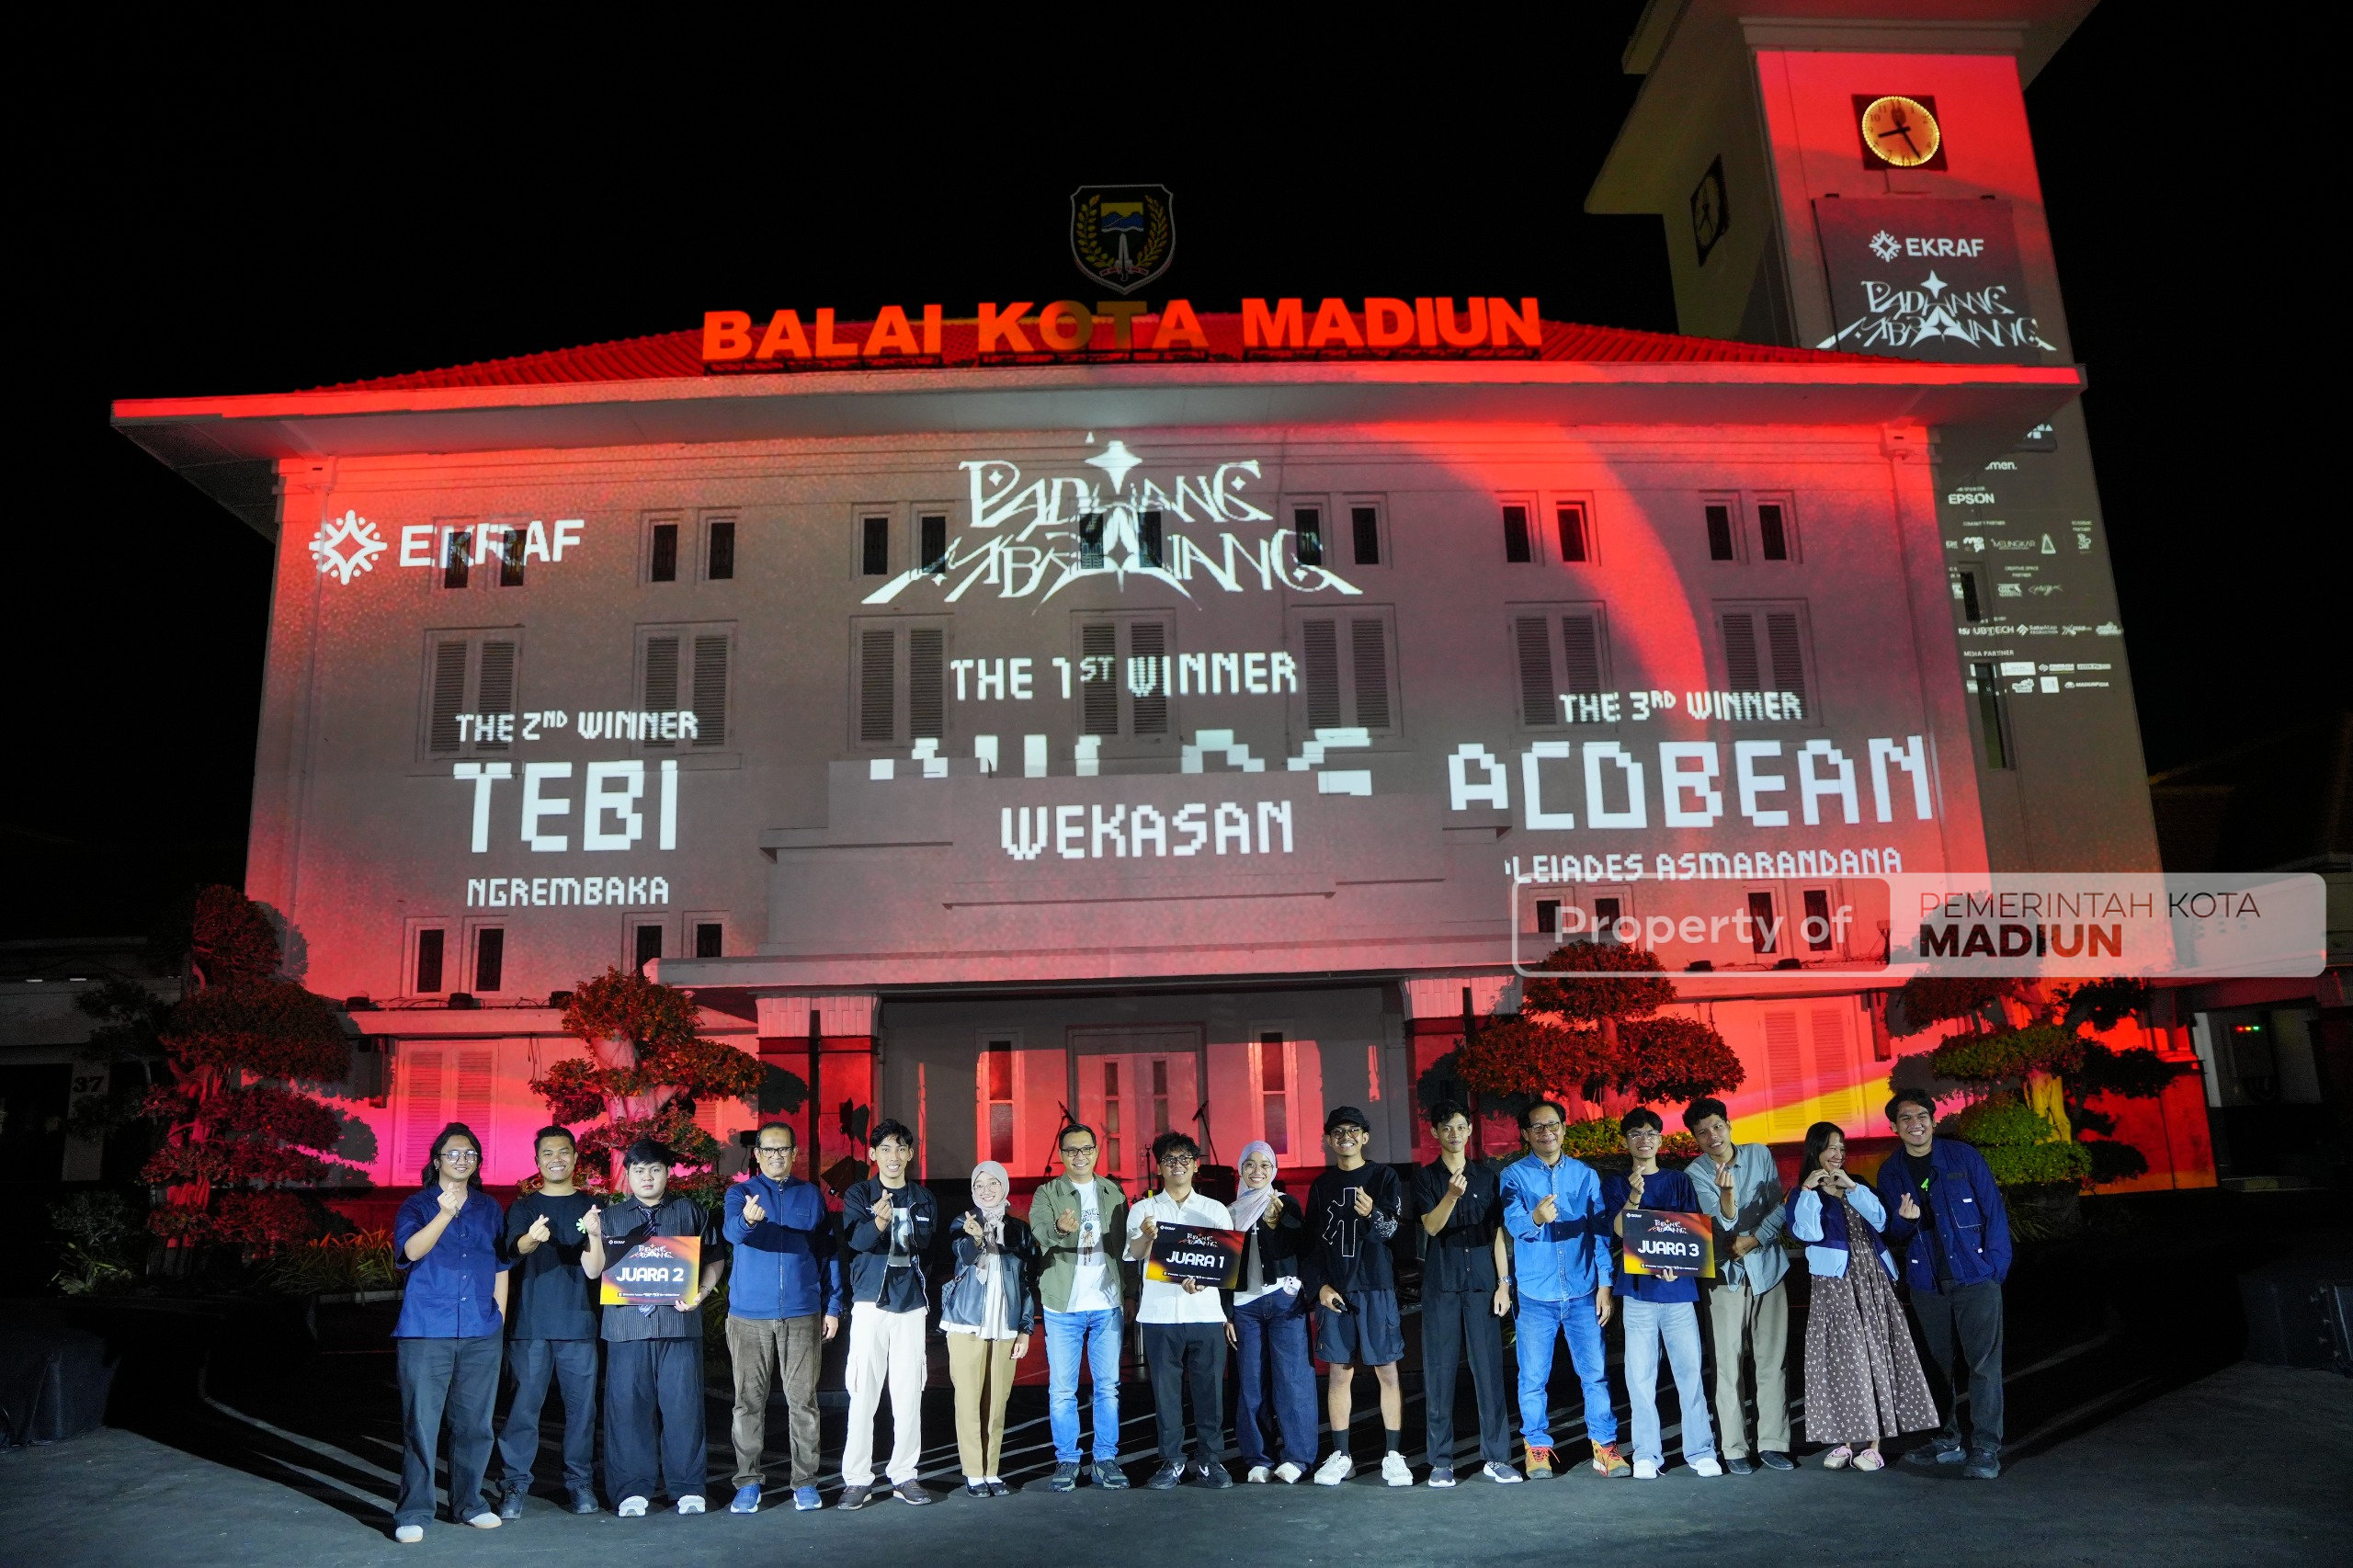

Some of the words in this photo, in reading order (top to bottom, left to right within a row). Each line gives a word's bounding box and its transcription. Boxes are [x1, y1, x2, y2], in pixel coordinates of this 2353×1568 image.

[1905, 237, 1984, 257] EKRAF
[702, 303, 943, 362] BALAI
[976, 300, 1210, 354] KOTA
[1241, 296, 1542, 350] MADIUN
[1949, 492, 1995, 505] EPSON
[399, 518, 585, 569] EKRAF
[1984, 649, 2014, 657] PARTNER
[950, 657, 1033, 700] THE
[1051, 655, 1115, 699] 1ST
[1128, 652, 1297, 698] WINNER
[1560, 691, 1620, 722] THE
[1629, 689, 1677, 722] 3RD
[1687, 690, 1802, 721] WINNER
[455, 713, 516, 743] THE
[522, 710, 568, 741] 2ND
[577, 710, 699, 741] WINNER
[453, 759, 678, 853] TEBI
[1001, 800, 1293, 860] WEKASAN
[1656, 846, 1903, 881] ASMARANDANA
[466, 876, 669, 907] NGREMBAKA
[1166, 1251, 1215, 1267] JUARA
[1219, 1256, 1225, 1268] 1
[1637, 1240, 1686, 1256] JUARA
[1689, 1244, 1699, 1257] 3
[616, 1267, 669, 1282] JUARA
[672, 1267, 684, 1282] 2
